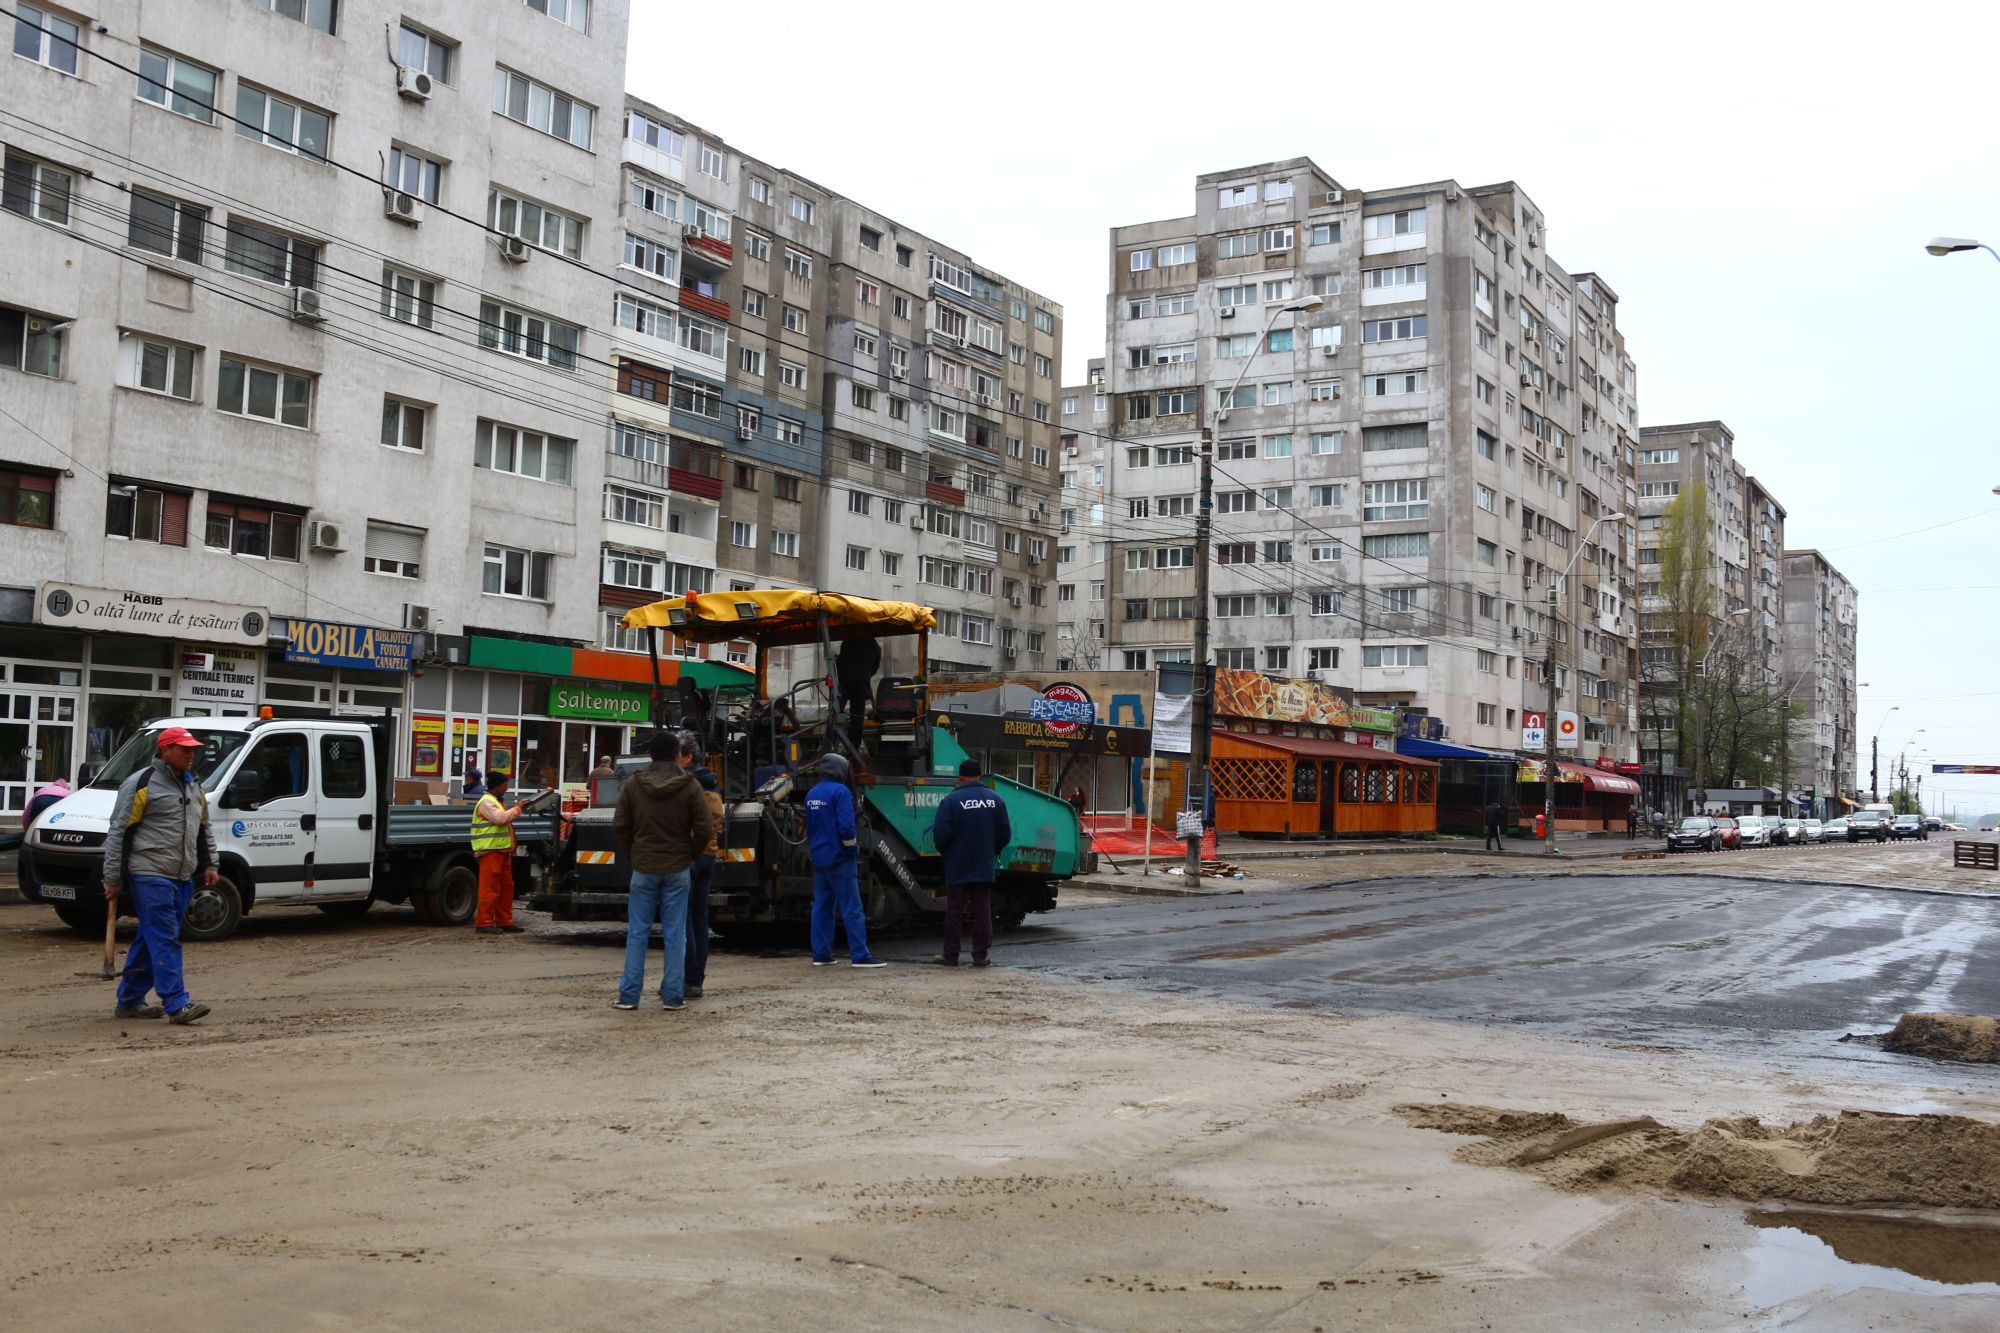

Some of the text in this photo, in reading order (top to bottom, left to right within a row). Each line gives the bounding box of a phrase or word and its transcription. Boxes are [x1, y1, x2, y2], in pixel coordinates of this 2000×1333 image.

[123, 593, 163, 606] HABIB
[75, 600, 90, 614] O
[128, 604, 164, 624] lume
[168, 609, 184, 625] de
[286, 620, 376, 659] MOBILA
[375, 630, 413, 645] BIBLIOTECI
[380, 643, 407, 657] FOTOLII
[375, 656, 409, 670] CANAPELE
[182, 670, 255, 685] CENTRALE TERMICE
[231, 689, 244, 698] GAZ
[1048, 687, 1080, 702] magazin
[557, 690, 641, 716] Saltempo
[1031, 699, 1094, 718] PESCARIE
[1003, 720, 1043, 737] FABRICA
[1044, 720, 1077, 734] alimentar
[960, 800, 996, 810] VEGA 93
[53, 833, 84, 843] IVECO
[878, 840, 897, 864] SUPER
